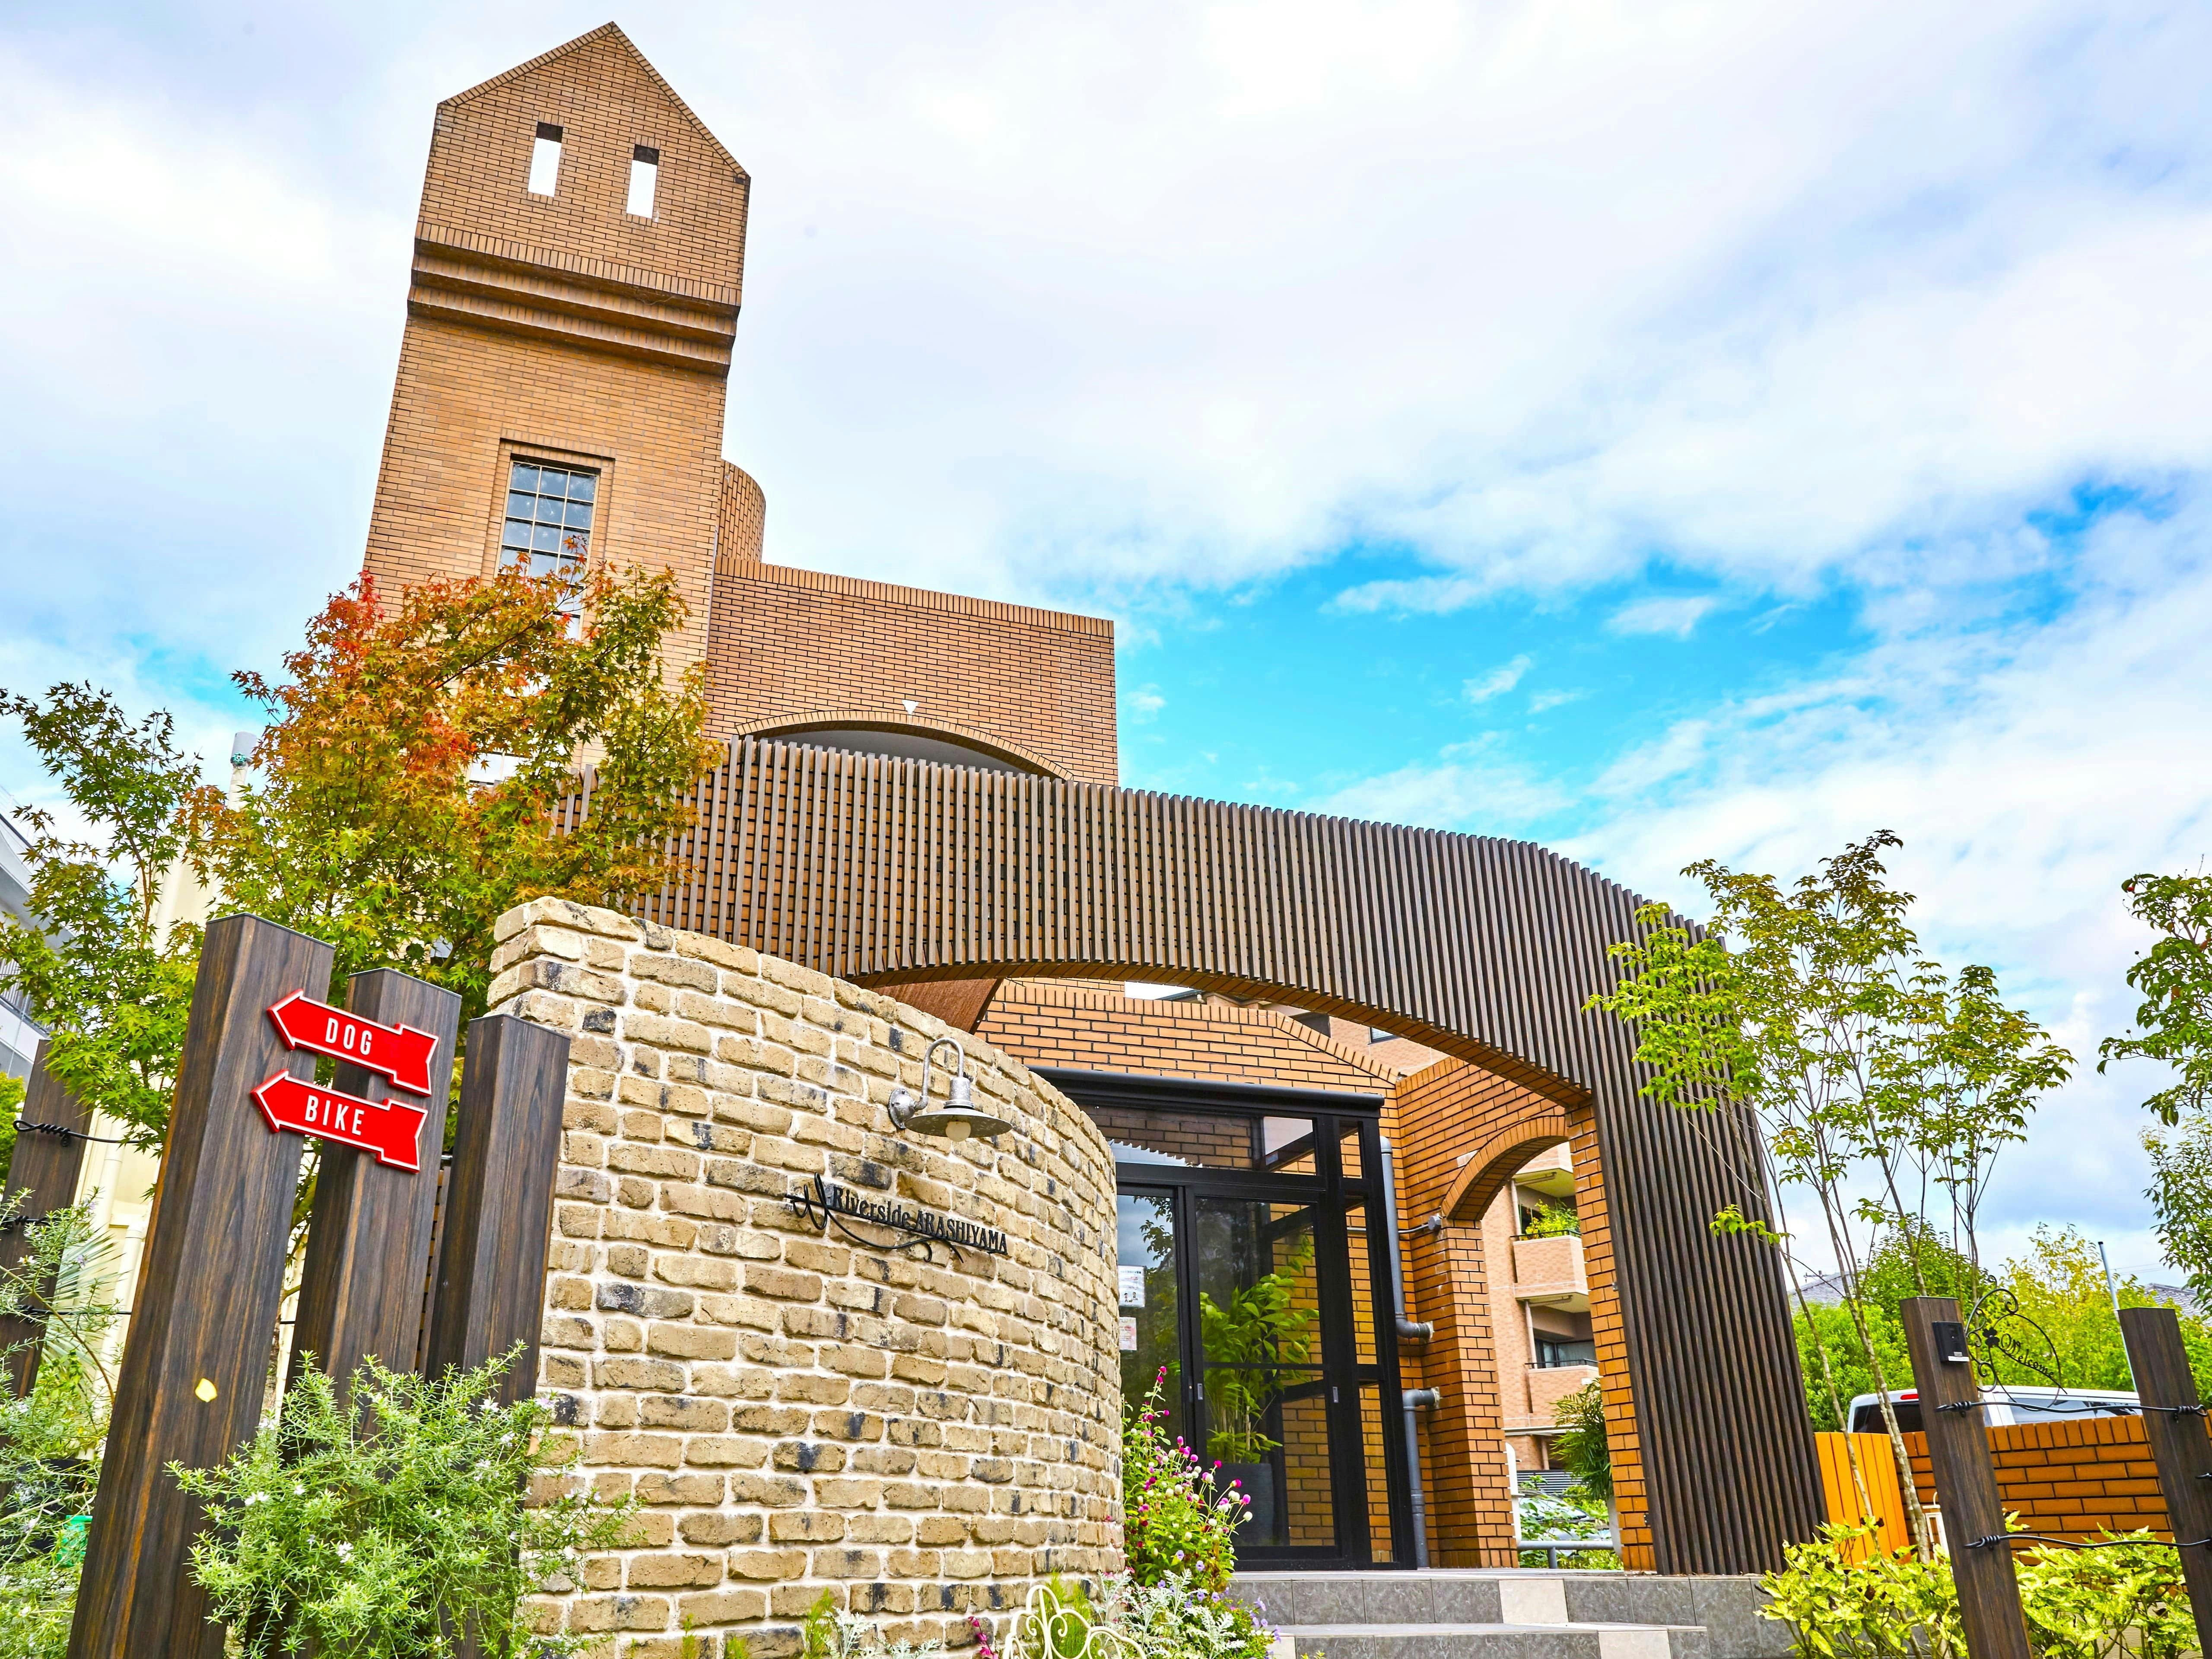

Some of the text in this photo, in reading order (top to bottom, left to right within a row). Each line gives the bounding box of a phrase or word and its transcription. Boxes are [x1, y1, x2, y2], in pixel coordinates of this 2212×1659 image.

[325, 1017, 372, 1055] DOG
[305, 1095, 365, 1135] BIKE
[833, 1186, 1007, 1253] Riverside ARASHIYAMA
[2001, 1333, 2054, 1376] Welcome
